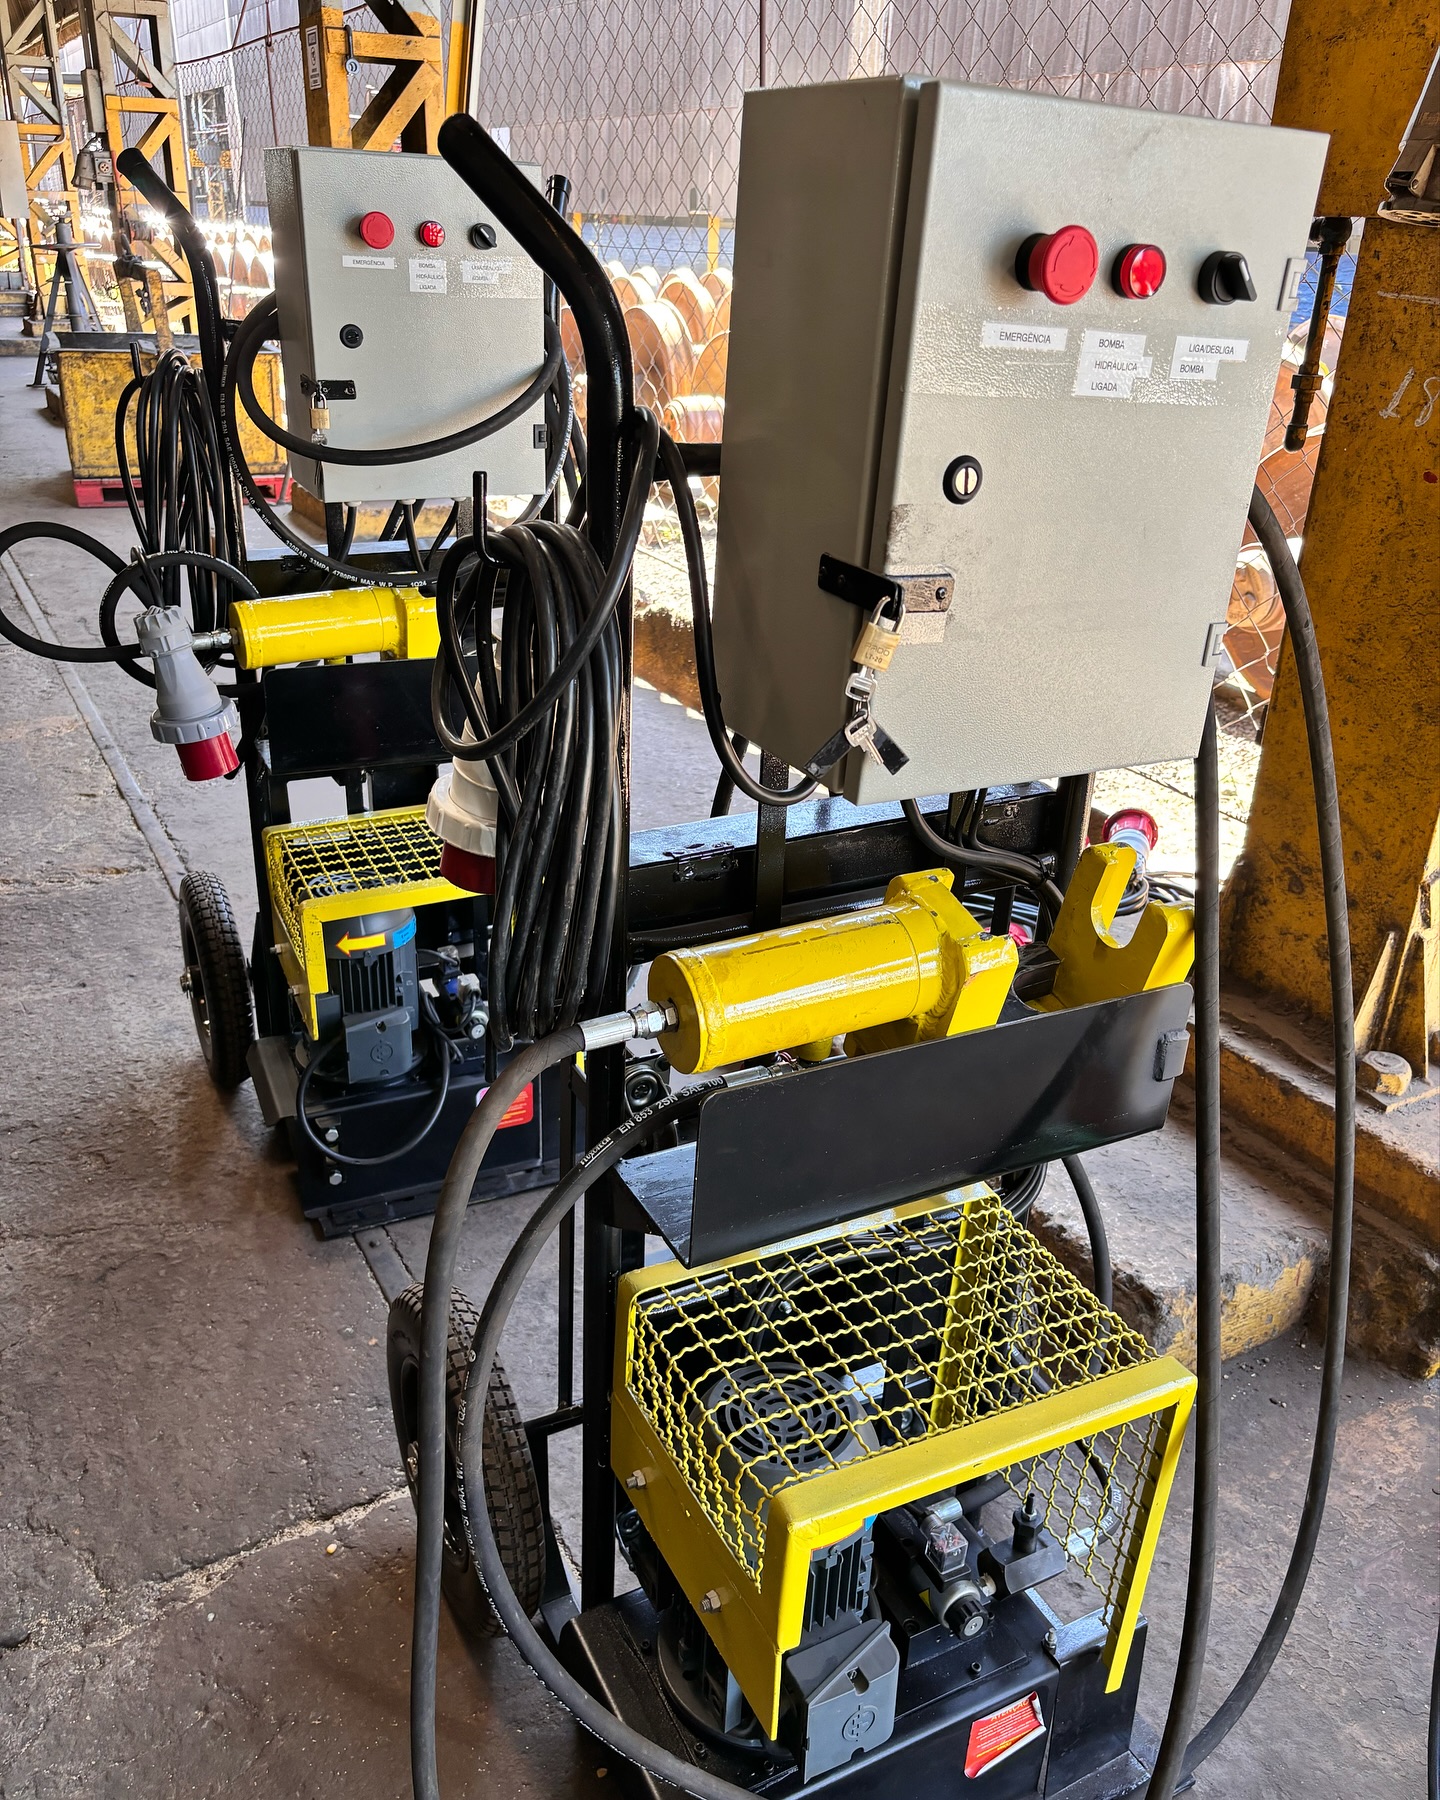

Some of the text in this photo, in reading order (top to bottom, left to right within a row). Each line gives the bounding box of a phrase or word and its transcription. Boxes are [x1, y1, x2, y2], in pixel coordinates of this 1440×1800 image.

[999, 331, 1051, 344] EMERGÊNCIA
[1099, 338, 1125, 349] BOMBA
[1094, 359, 1138, 371] HIDRÁULICA
[1180, 363, 1205, 374] BOMBA
[1090, 381, 1118, 391] LIGADA
[618, 1117, 635, 1134] EN
[634, 1107, 653, 1123] 853
[655, 1094, 679, 1110] 2SN
[681, 1083, 705, 1097] SAE
